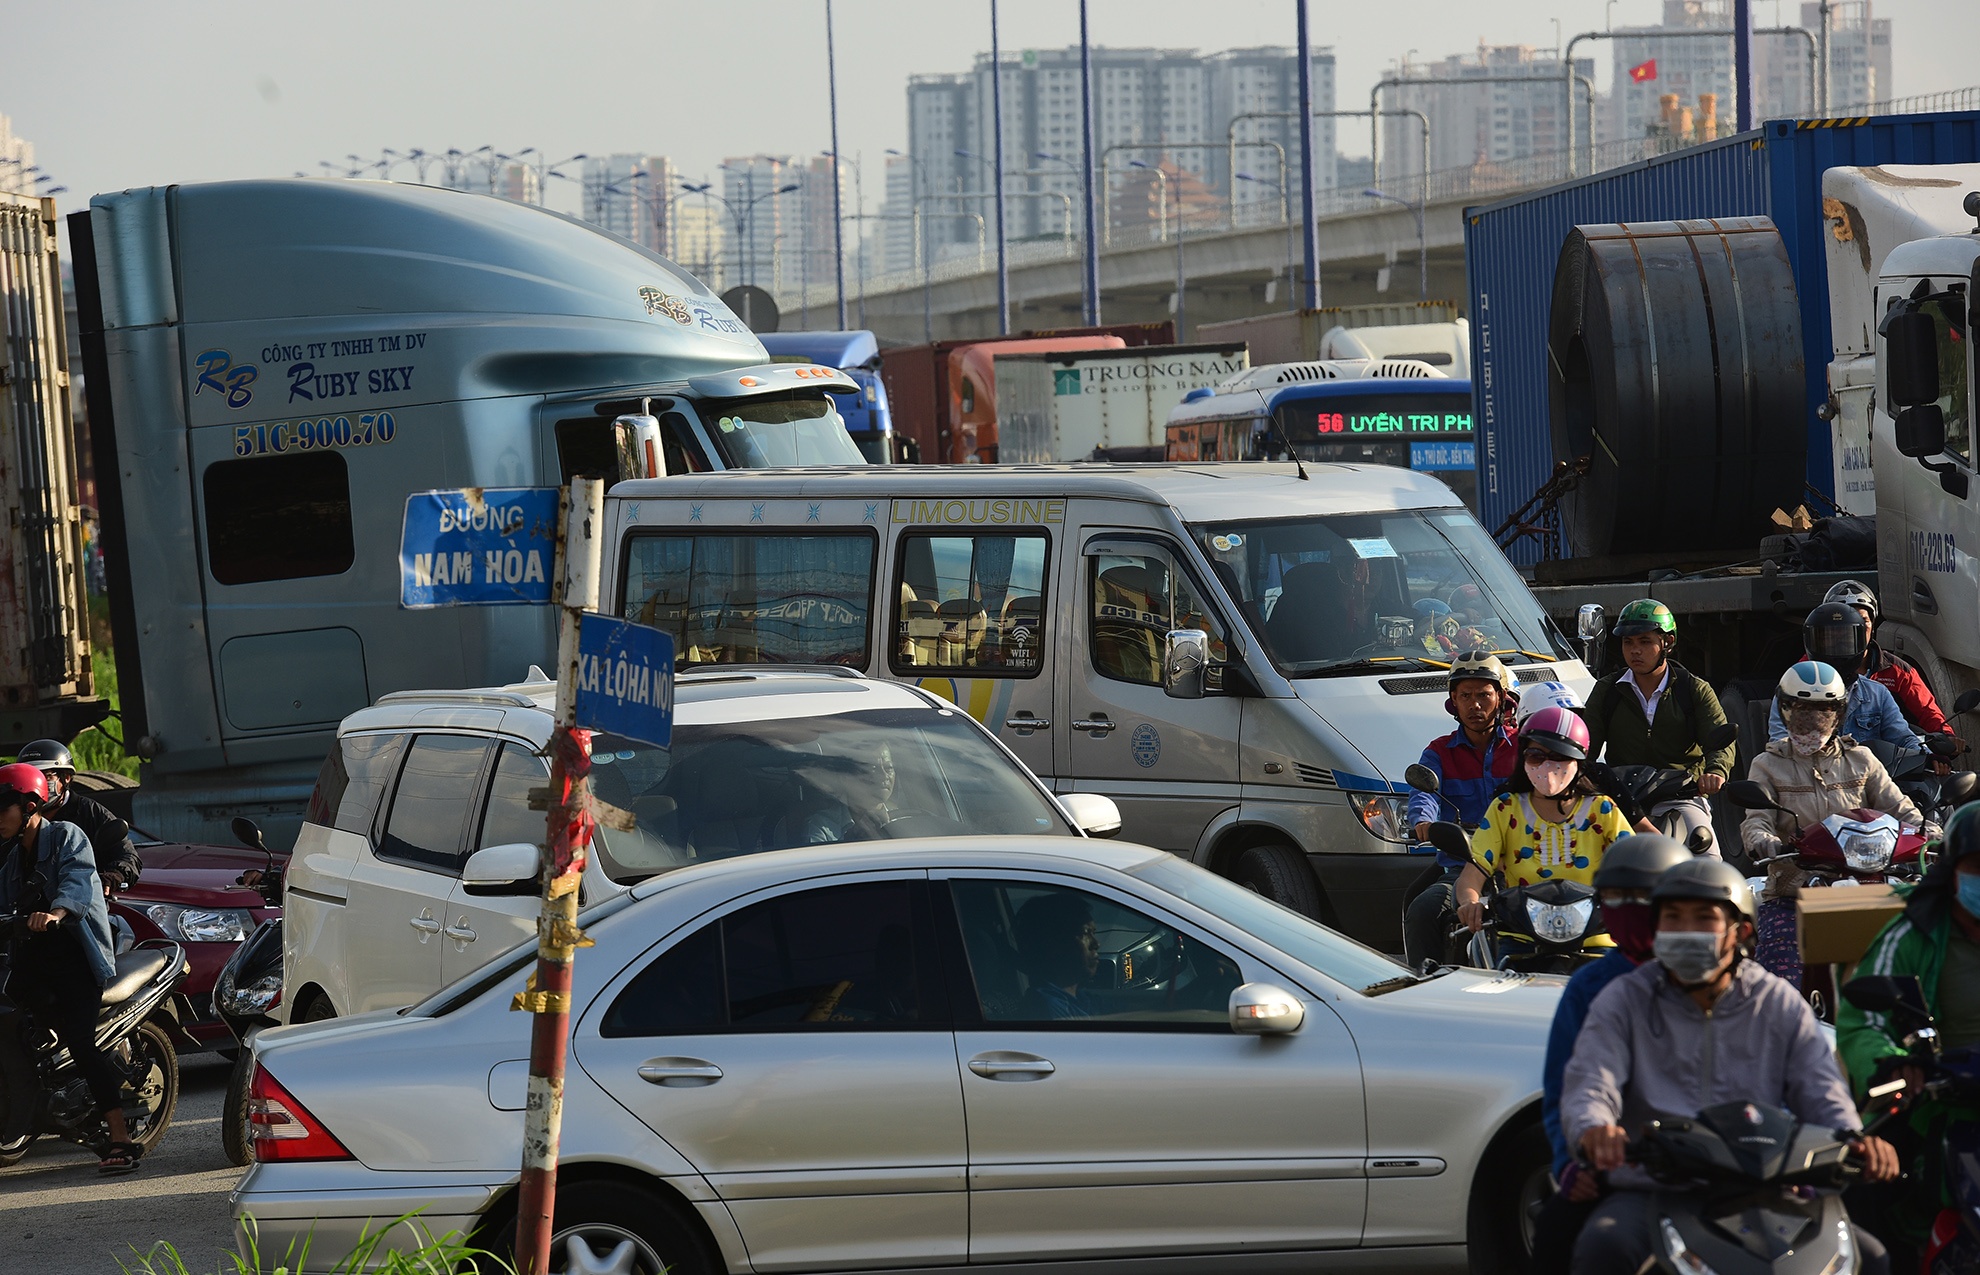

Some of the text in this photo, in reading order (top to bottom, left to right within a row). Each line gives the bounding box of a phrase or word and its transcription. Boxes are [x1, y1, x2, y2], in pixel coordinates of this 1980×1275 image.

[262, 333, 427, 363] CÔNG TY TNHH TM DV
[287, 362, 414, 404] RUBY SKY
[1084, 360, 1244, 382] TRUONG NAM
[235, 411, 397, 457] 51C-900.70
[1317, 413, 1344, 433] 56
[1351, 412, 1403, 432] UYỄN
[1407, 415, 1439, 432] TRI
[891, 500, 1065, 524] LIMOUSINE
[414, 539, 545, 587] NAM HÒA
[1909, 530, 1956, 573] 61C-229.63
[1011, 649, 1030, 658] WIFI
[577, 653, 600, 693] XA
[652, 662, 673, 719] NỘI
